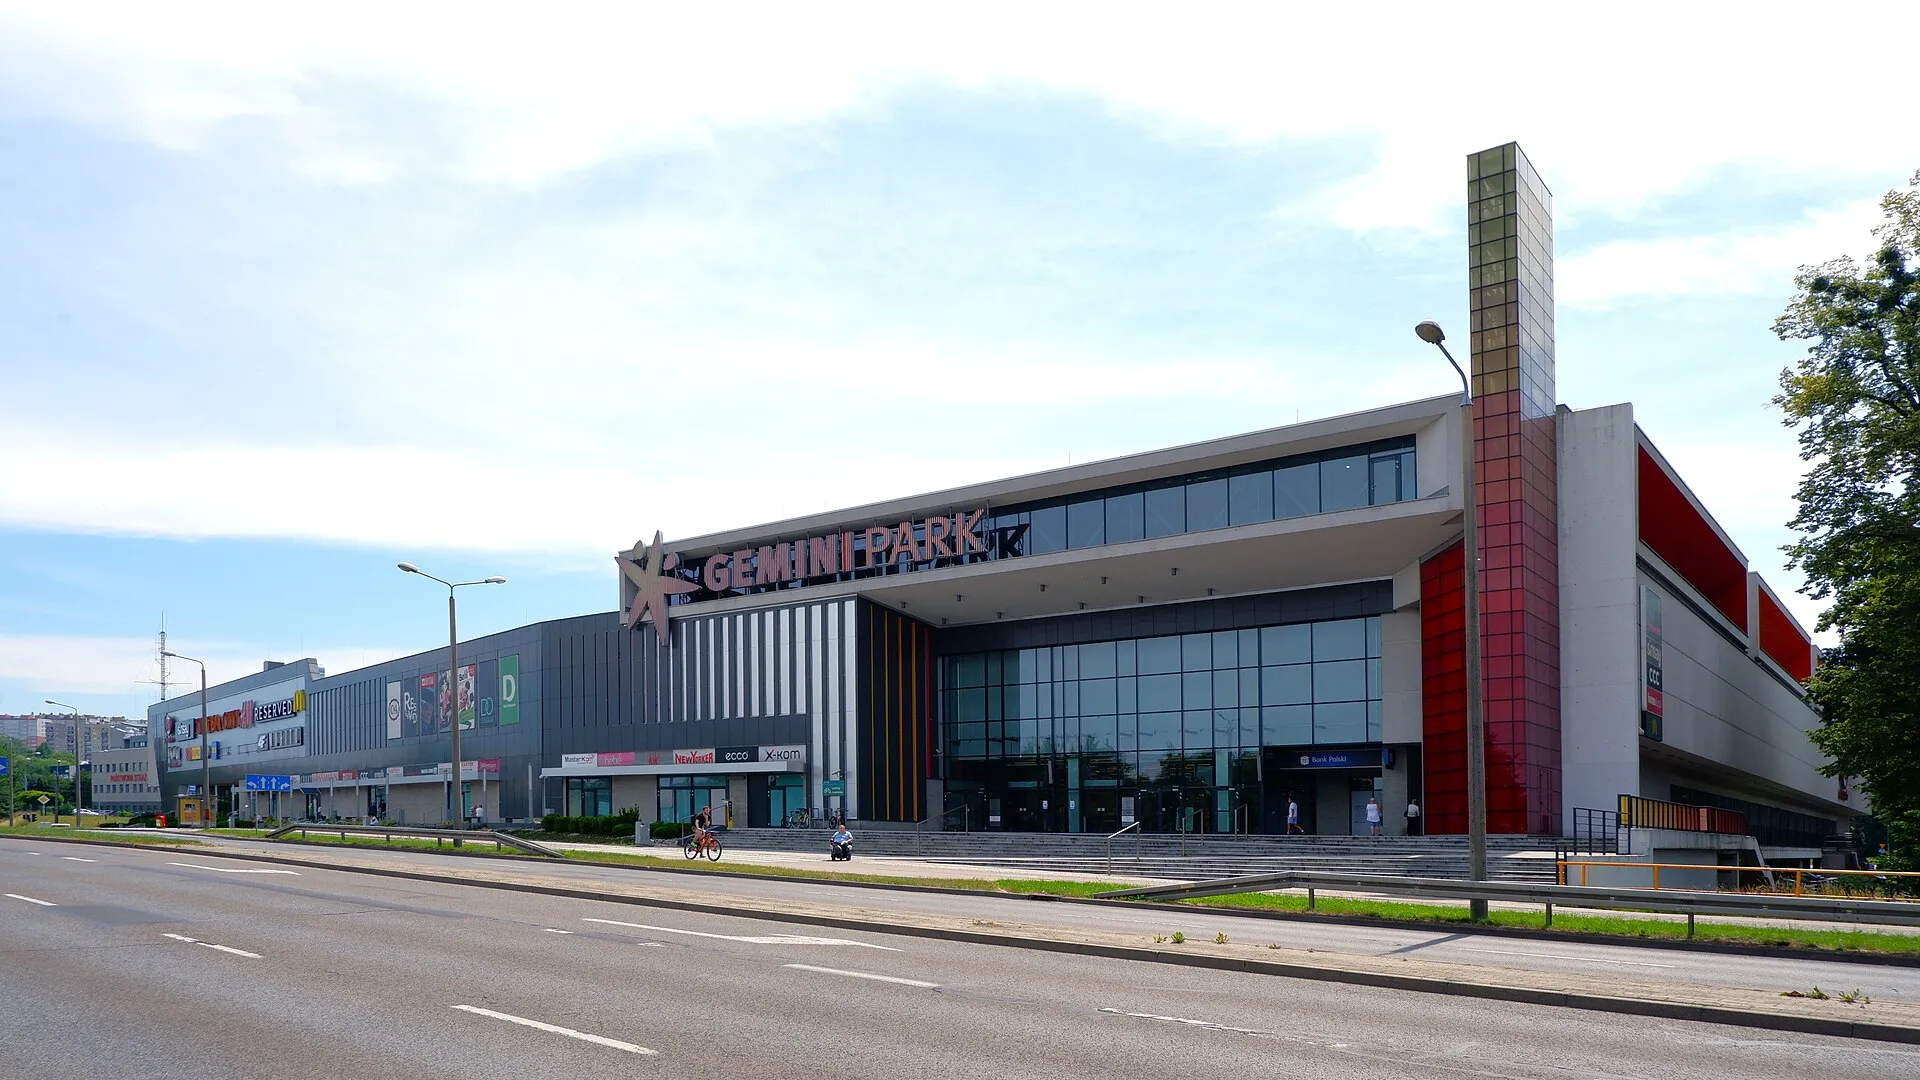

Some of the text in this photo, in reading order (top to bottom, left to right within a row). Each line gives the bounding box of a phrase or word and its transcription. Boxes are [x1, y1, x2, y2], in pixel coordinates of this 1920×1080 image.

[704, 508, 986, 592] GEMINI PARK
[1648, 667, 1660, 686] CCC
[254, 701, 293, 721] RESERVED
[725, 751, 749, 761] ecco
[1329, 755, 1347, 763] Polski
